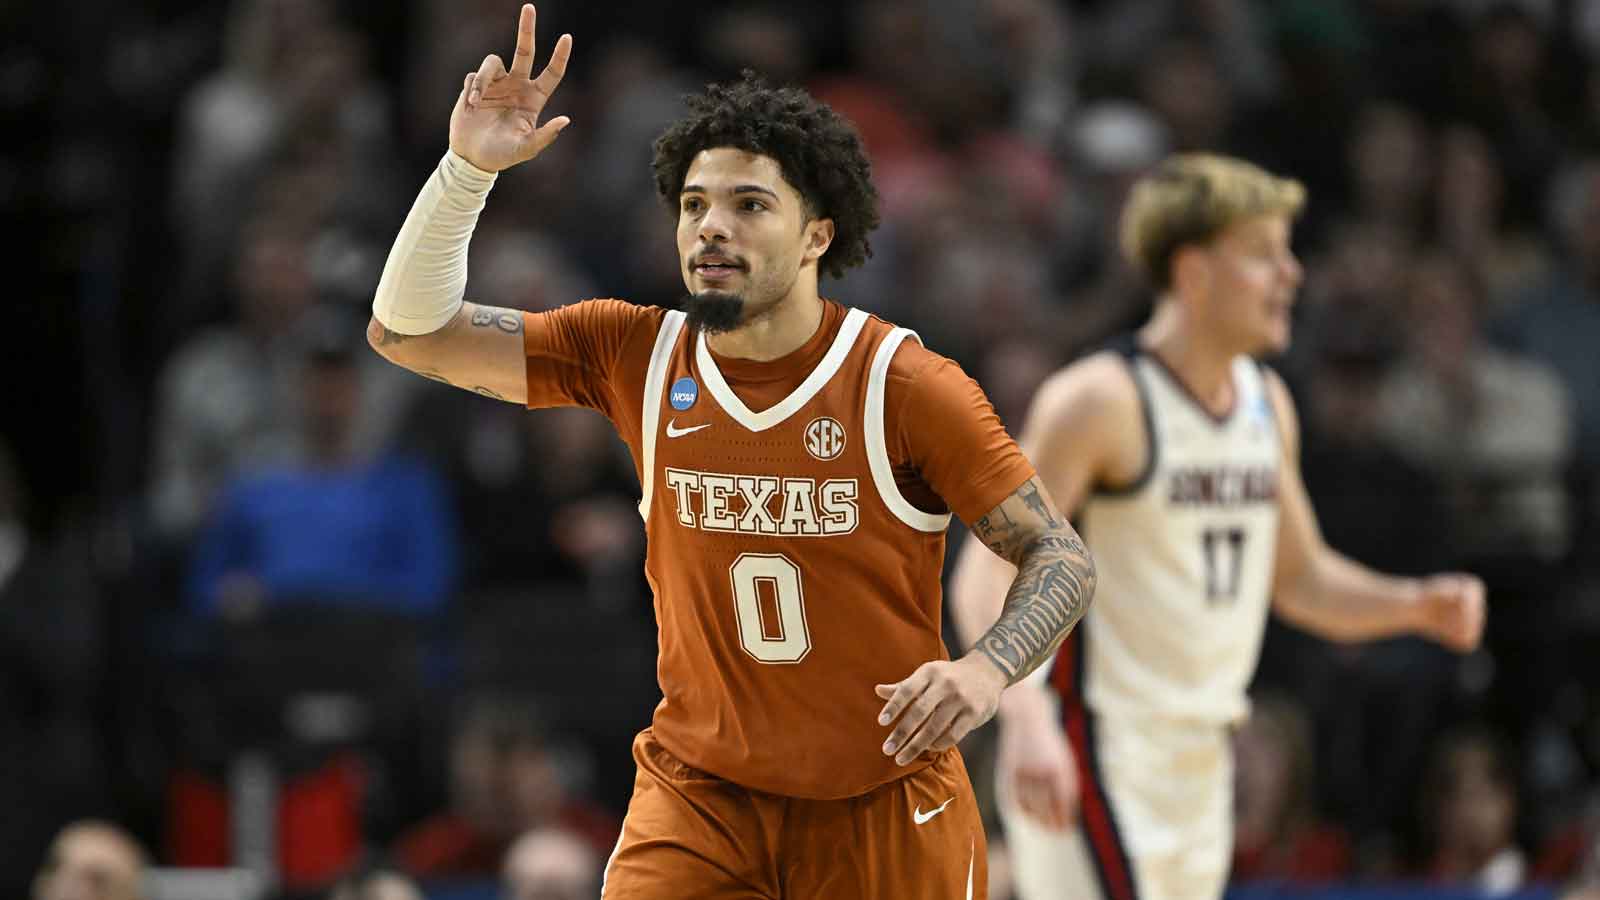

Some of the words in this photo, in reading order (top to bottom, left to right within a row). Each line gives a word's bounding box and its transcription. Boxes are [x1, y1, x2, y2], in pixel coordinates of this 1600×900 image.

[672, 392, 696, 402] NCAA
[806, 420, 843, 458] SEC
[665, 467, 860, 537] TEXAS
[729, 552, 812, 664] 0
